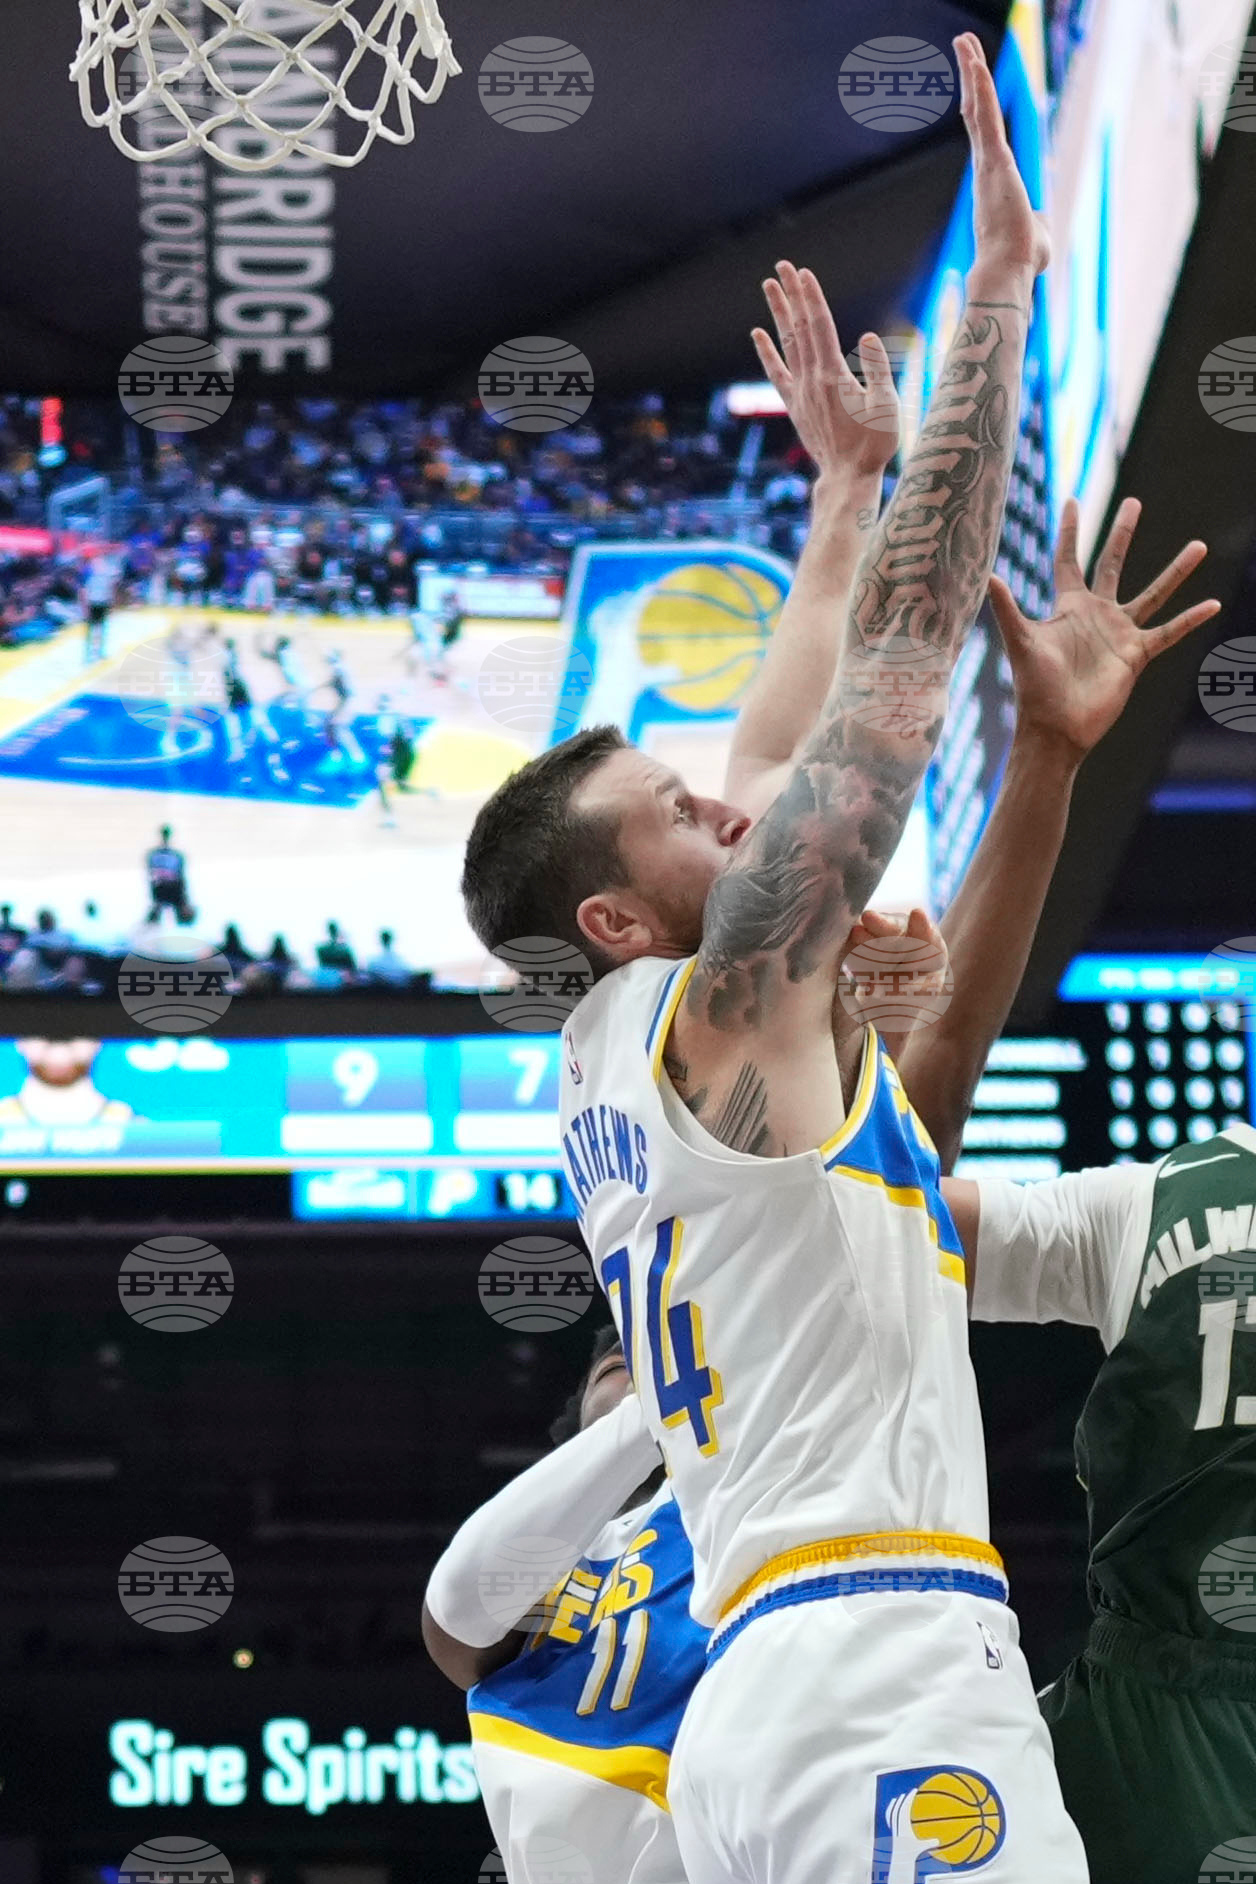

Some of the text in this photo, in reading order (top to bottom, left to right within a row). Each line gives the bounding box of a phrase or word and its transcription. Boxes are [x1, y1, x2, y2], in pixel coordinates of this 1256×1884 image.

[332, 1048, 379, 1107] 9
[509, 1047, 549, 1105] 7
[502, 1172, 557, 1212] 14
[563, 1105, 649, 1222] ATHEWS
[576, 1608, 651, 1716] 11
[110, 1718, 480, 1815] Sire Spirits
